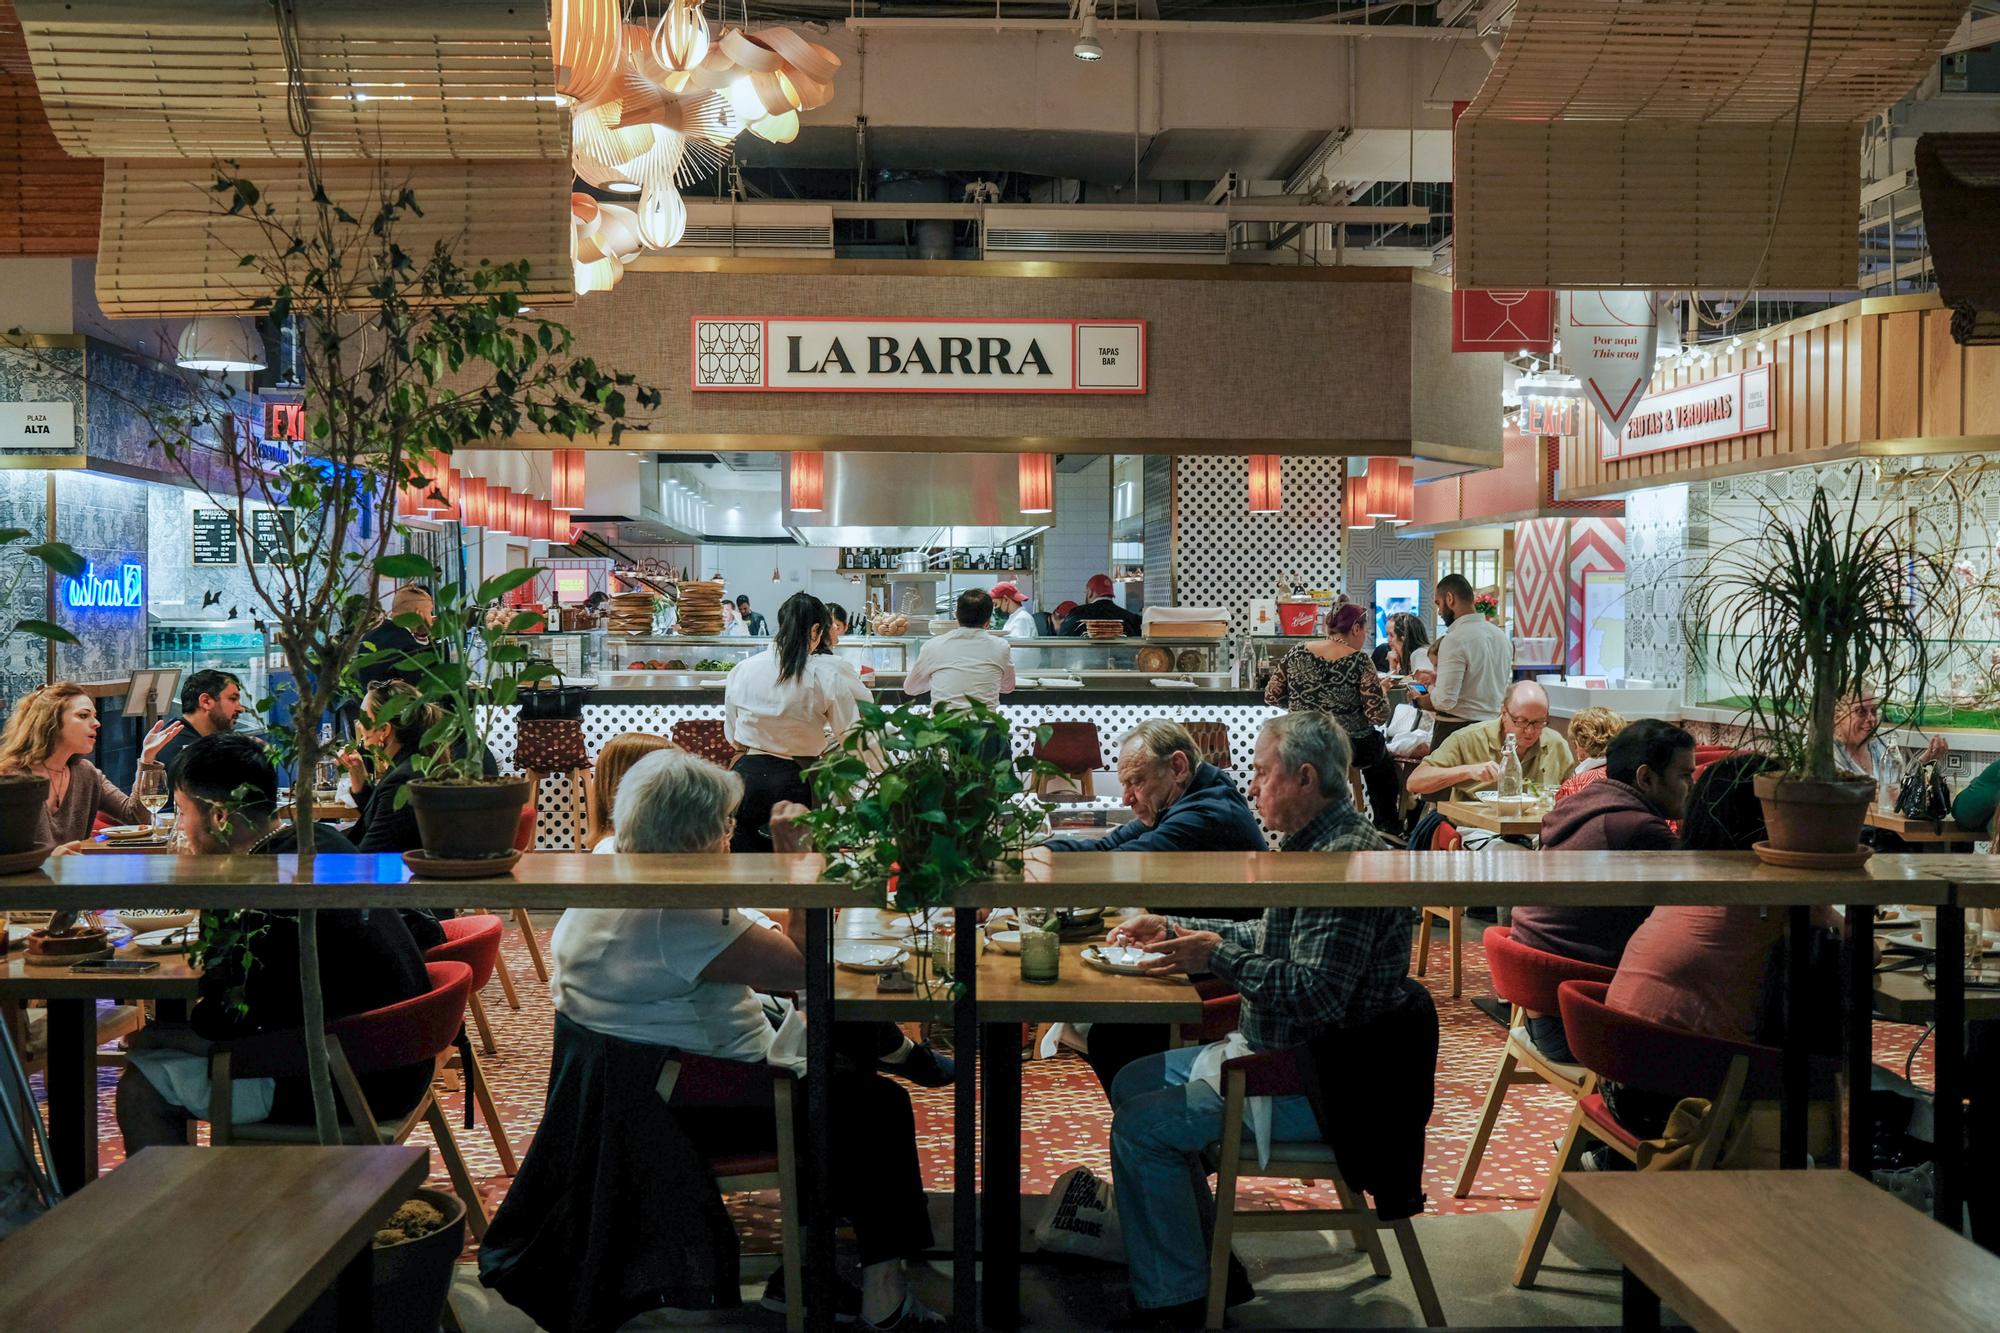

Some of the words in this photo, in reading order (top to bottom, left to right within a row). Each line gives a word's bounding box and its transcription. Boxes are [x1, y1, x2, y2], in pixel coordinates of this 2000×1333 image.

[1593, 336, 1612, 345] Por
[786, 335, 856, 374] LA
[867, 335, 1053, 375] BARRA
[1098, 347, 1120, 356] TAPAS
[1592, 349, 1615, 358] This
[1617, 351, 1640, 361] way
[1102, 357, 1116, 366] BAR
[26, 414, 48, 422] PLAZA
[1529, 399, 1573, 435] EXIT
[1628, 411, 1663, 439] FRUTAS
[1664, 408, 1674, 432] &
[1675, 393, 1732, 429] VERDURAS
[272, 404, 305, 440] EXI
[24, 425, 50, 434] ALTA
